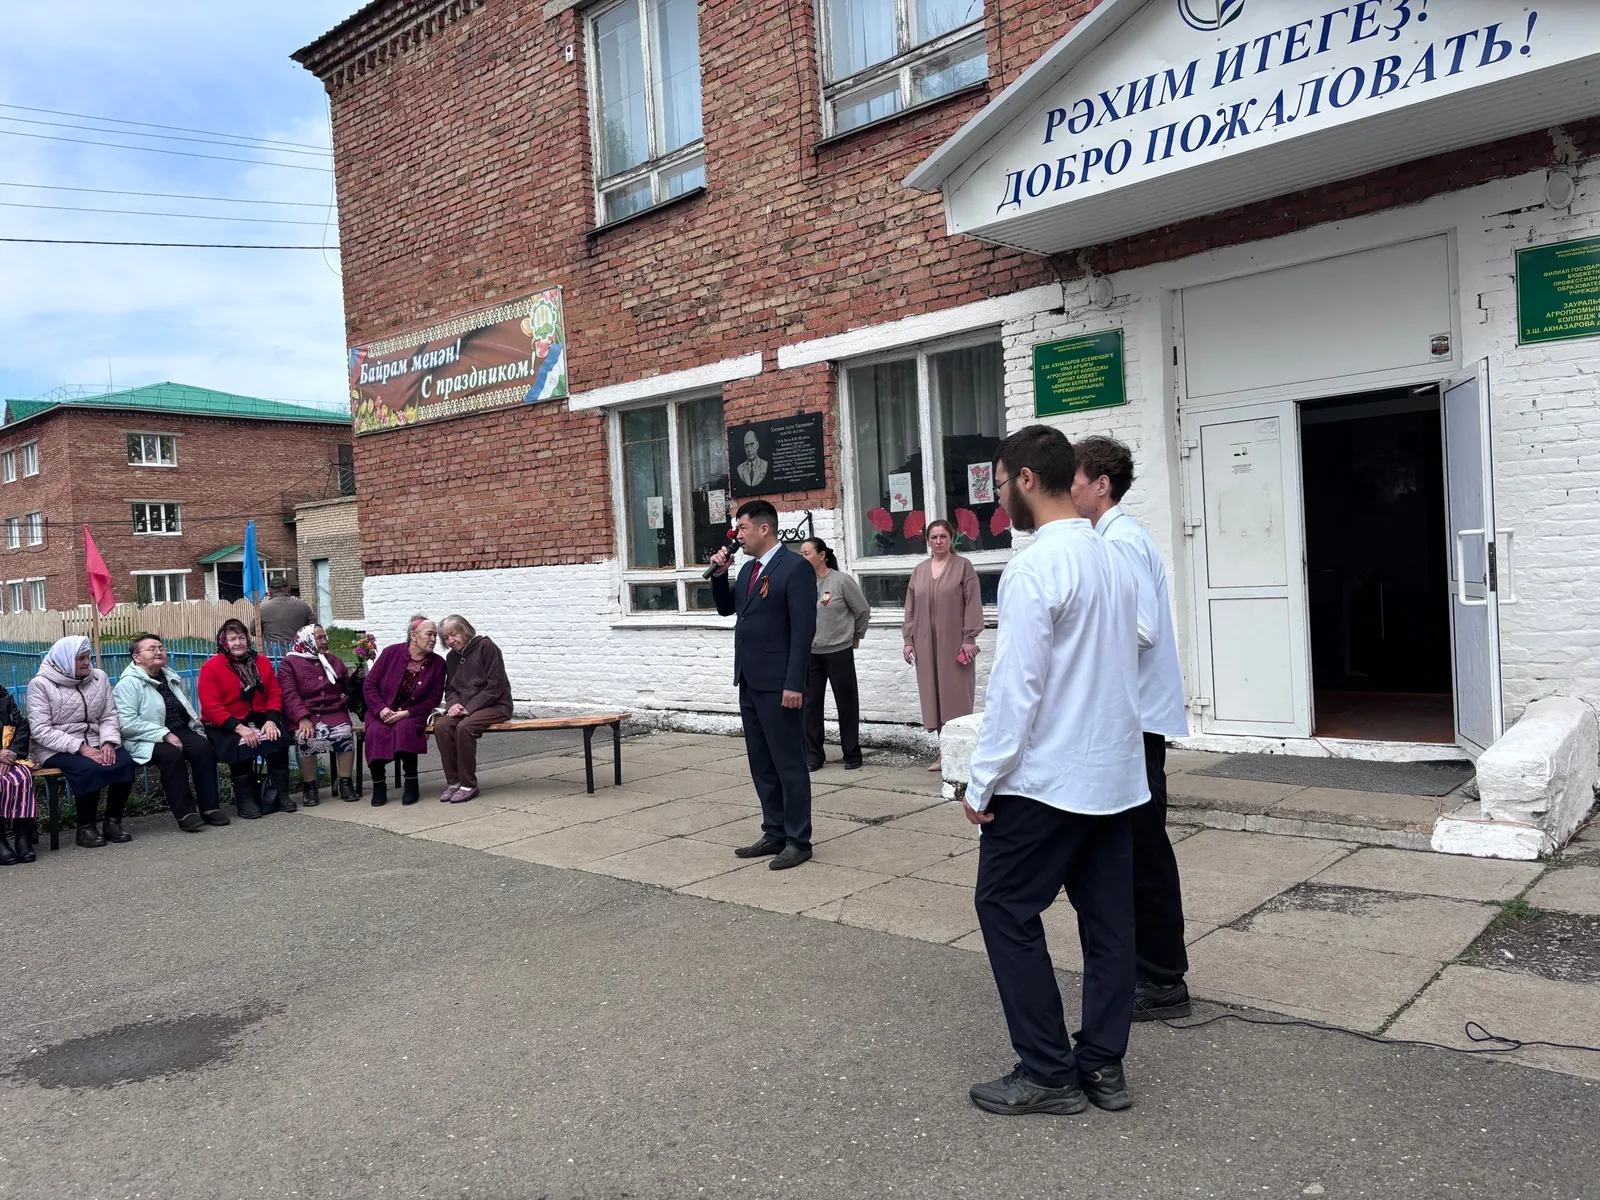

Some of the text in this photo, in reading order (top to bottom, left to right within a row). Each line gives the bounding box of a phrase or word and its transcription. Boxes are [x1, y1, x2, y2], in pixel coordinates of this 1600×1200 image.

[996, 11, 1538, 215] ДОБРО ПОЖАЛОВАТЬ!
[1042, 58, 1201, 145] РӘХИМ
[1543, 268, 1570, 277] ФИЛИАЛ
[1543, 320, 1595, 333] АКНАЗАРОВА
[1557, 313, 1596, 323] КОЛЛЕДЖ
[359, 338, 461, 386] Байрам менән!
[421, 350, 536, 400] С праздником!
